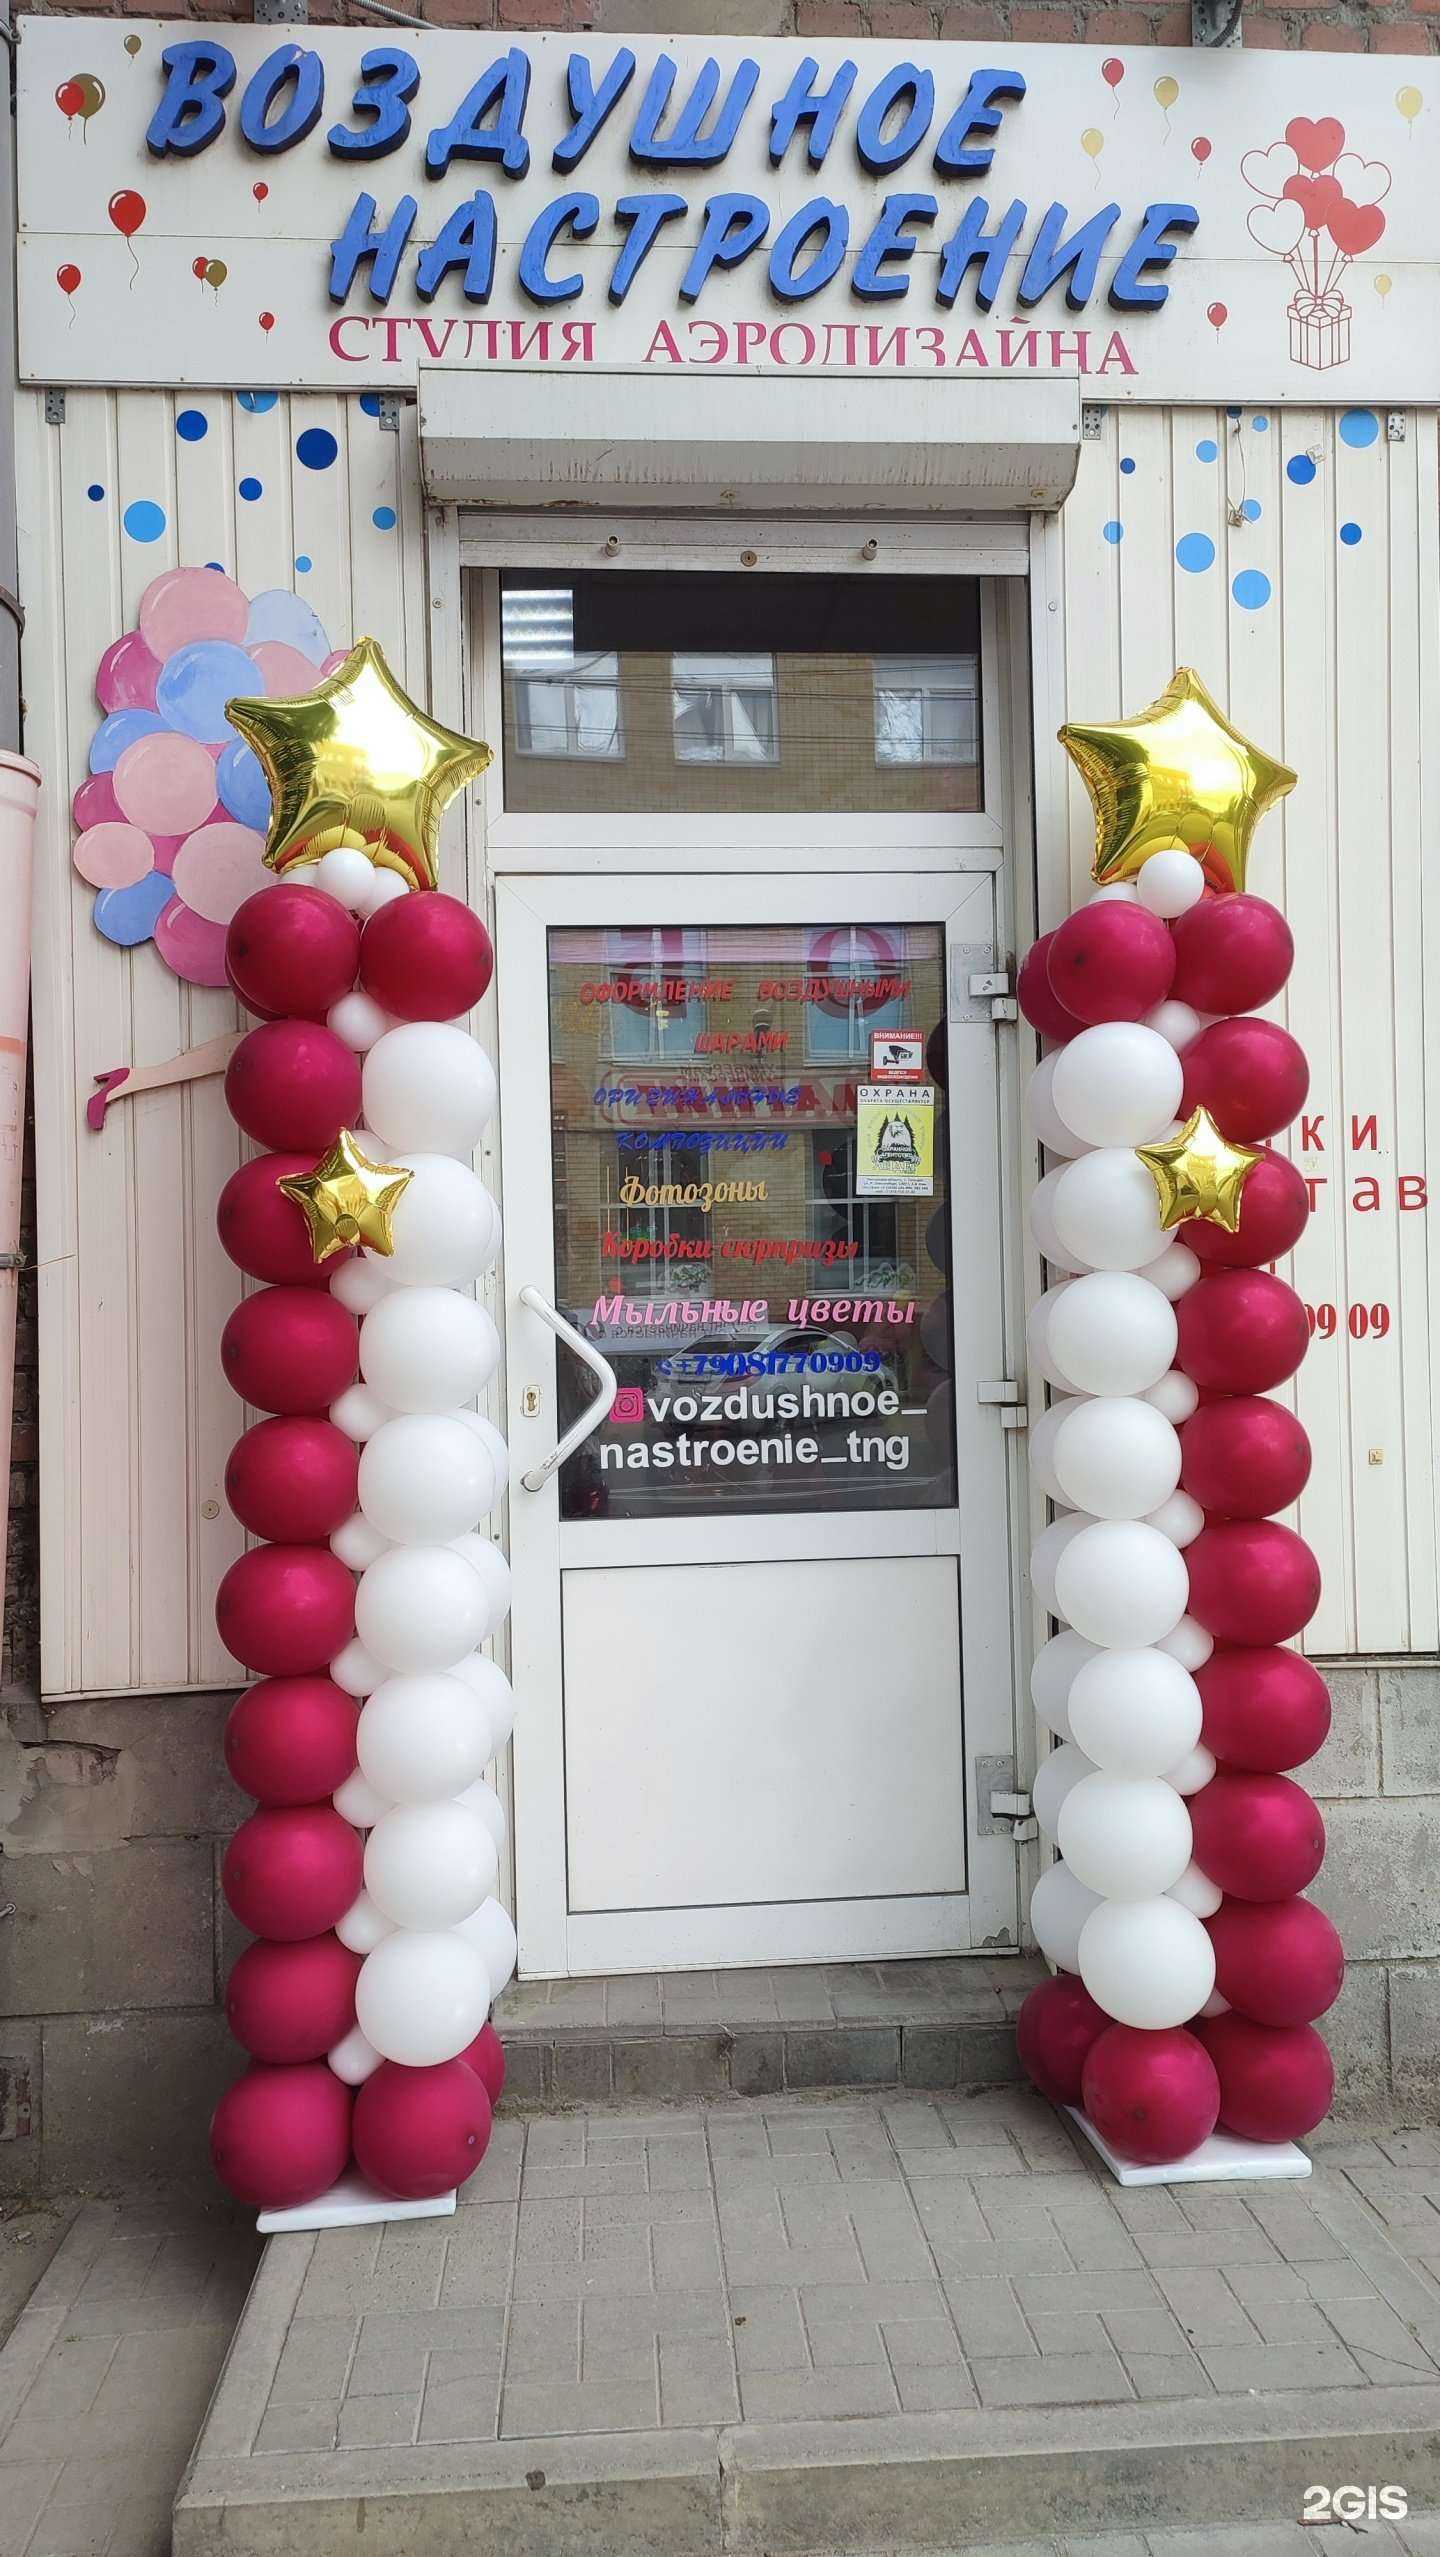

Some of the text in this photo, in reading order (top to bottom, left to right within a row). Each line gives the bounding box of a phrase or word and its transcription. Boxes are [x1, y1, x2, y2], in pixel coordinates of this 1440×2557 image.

[146, 40, 1027, 181] ВОЗДУШНОЕ
[329, 189, 1199, 314] НАСТРОЕНИЕ
[694, 1030, 790, 1054] ШАРАМИ
[860, 1088, 931, 1099] ОХРАНА
[1301, 1114, 1378, 1152] ки
[619, 1175, 769, 1213] Фотозоны
[601, 1231, 713, 1264] Коробки
[589, 1295, 916, 1329] Мыльные цветы
[646, 1385, 928, 1422] vozdushnoe_
[601, 1430, 911, 1471] nastroenie_tng
